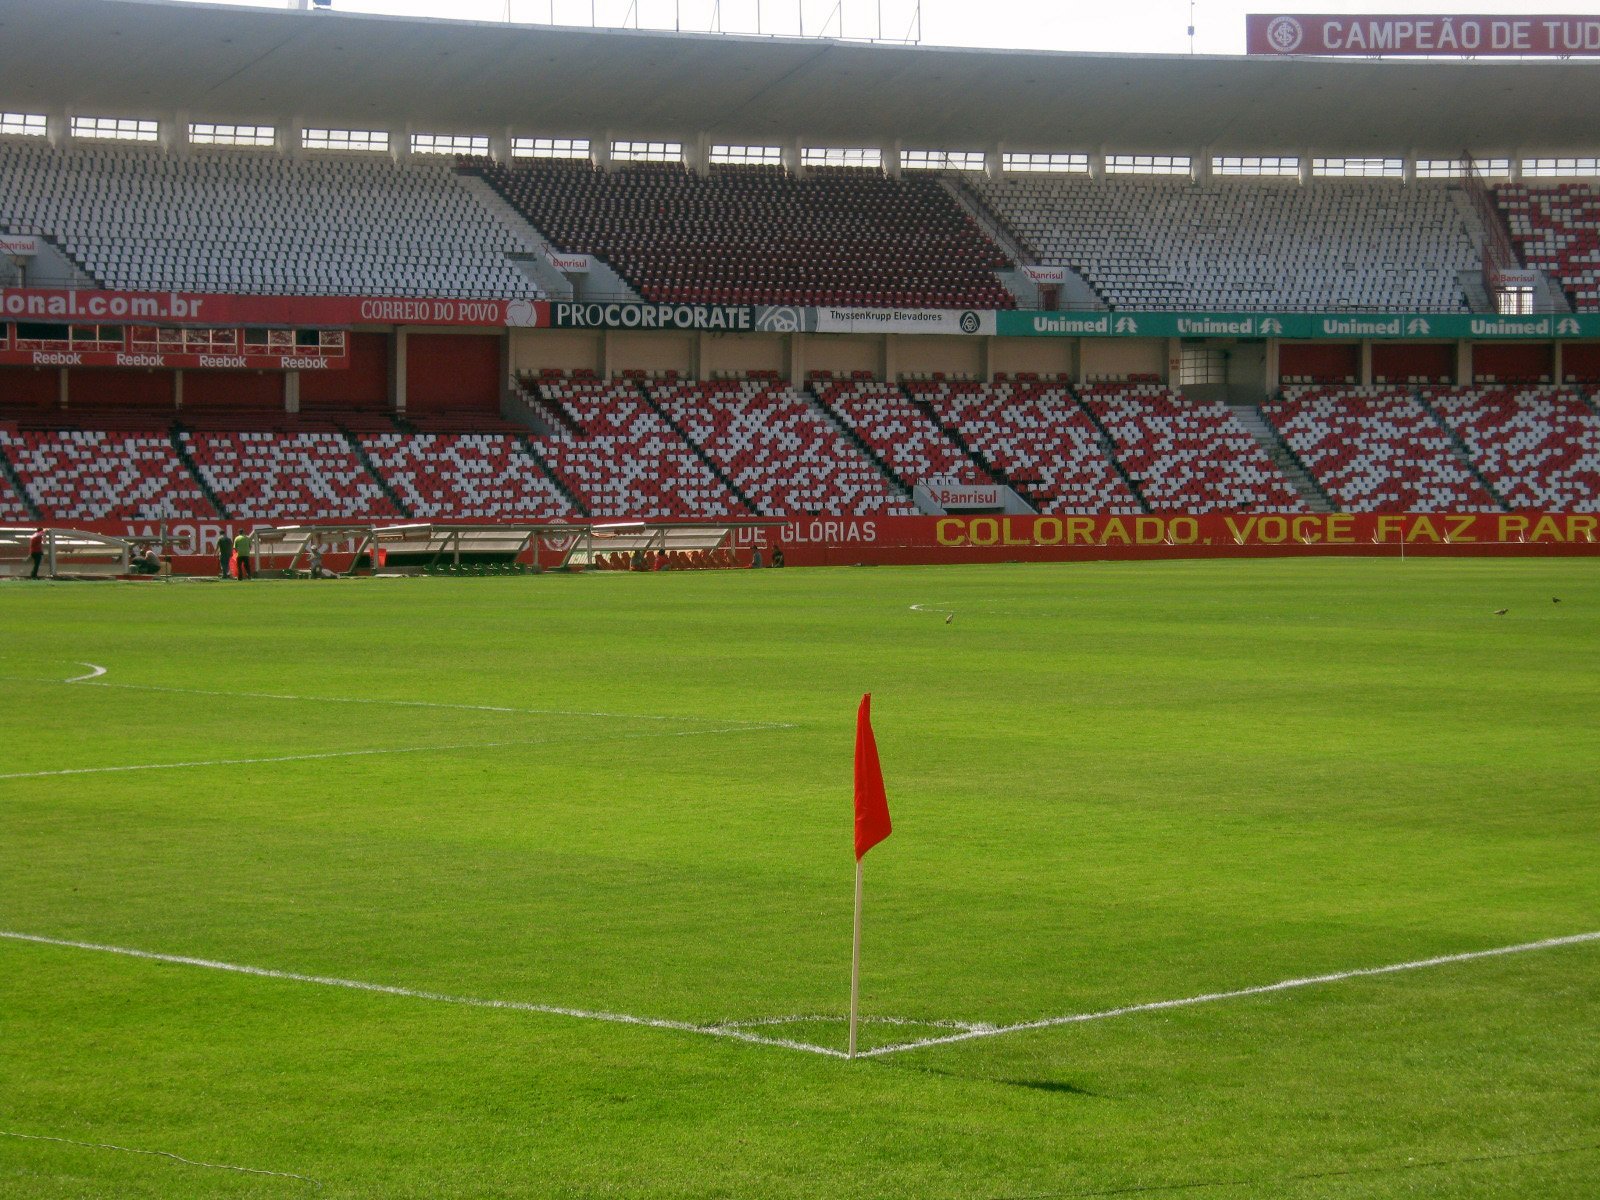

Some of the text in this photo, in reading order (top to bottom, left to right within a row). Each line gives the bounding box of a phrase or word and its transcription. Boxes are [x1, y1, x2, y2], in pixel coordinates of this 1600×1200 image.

[1323, 16, 1481, 49] CAMPEÃO
[1491, 21, 1531, 49] DE
[1030, 270, 1063, 280] Banrisul
[1500, 274, 1535, 283] Banrisul
[361, 300, 499, 322] CORREIO DO POVO
[557, 303, 750, 329] PROCORPORATE
[830, 310, 942, 322] ThyssenKrupp Elevadores
[1033, 316, 1108, 333] Unimed
[1177, 318, 1252, 334] Unimed
[1323, 319, 1400, 334] Unimed
[1471, 319, 1549, 335] Unimed
[33, 352, 82, 365] Reebok
[116, 354, 165, 367] Reebok
[200, 355, 247, 368] Reebok
[281, 356, 328, 369] Reebok
[941, 490, 997, 504] Banrisul
[780, 518, 876, 542] GLÓRIAS
[1224, 513, 1355, 543] VOCÊ
[1377, 515, 1476, 542] FAZ
[1499, 515, 1600, 542] PAR
